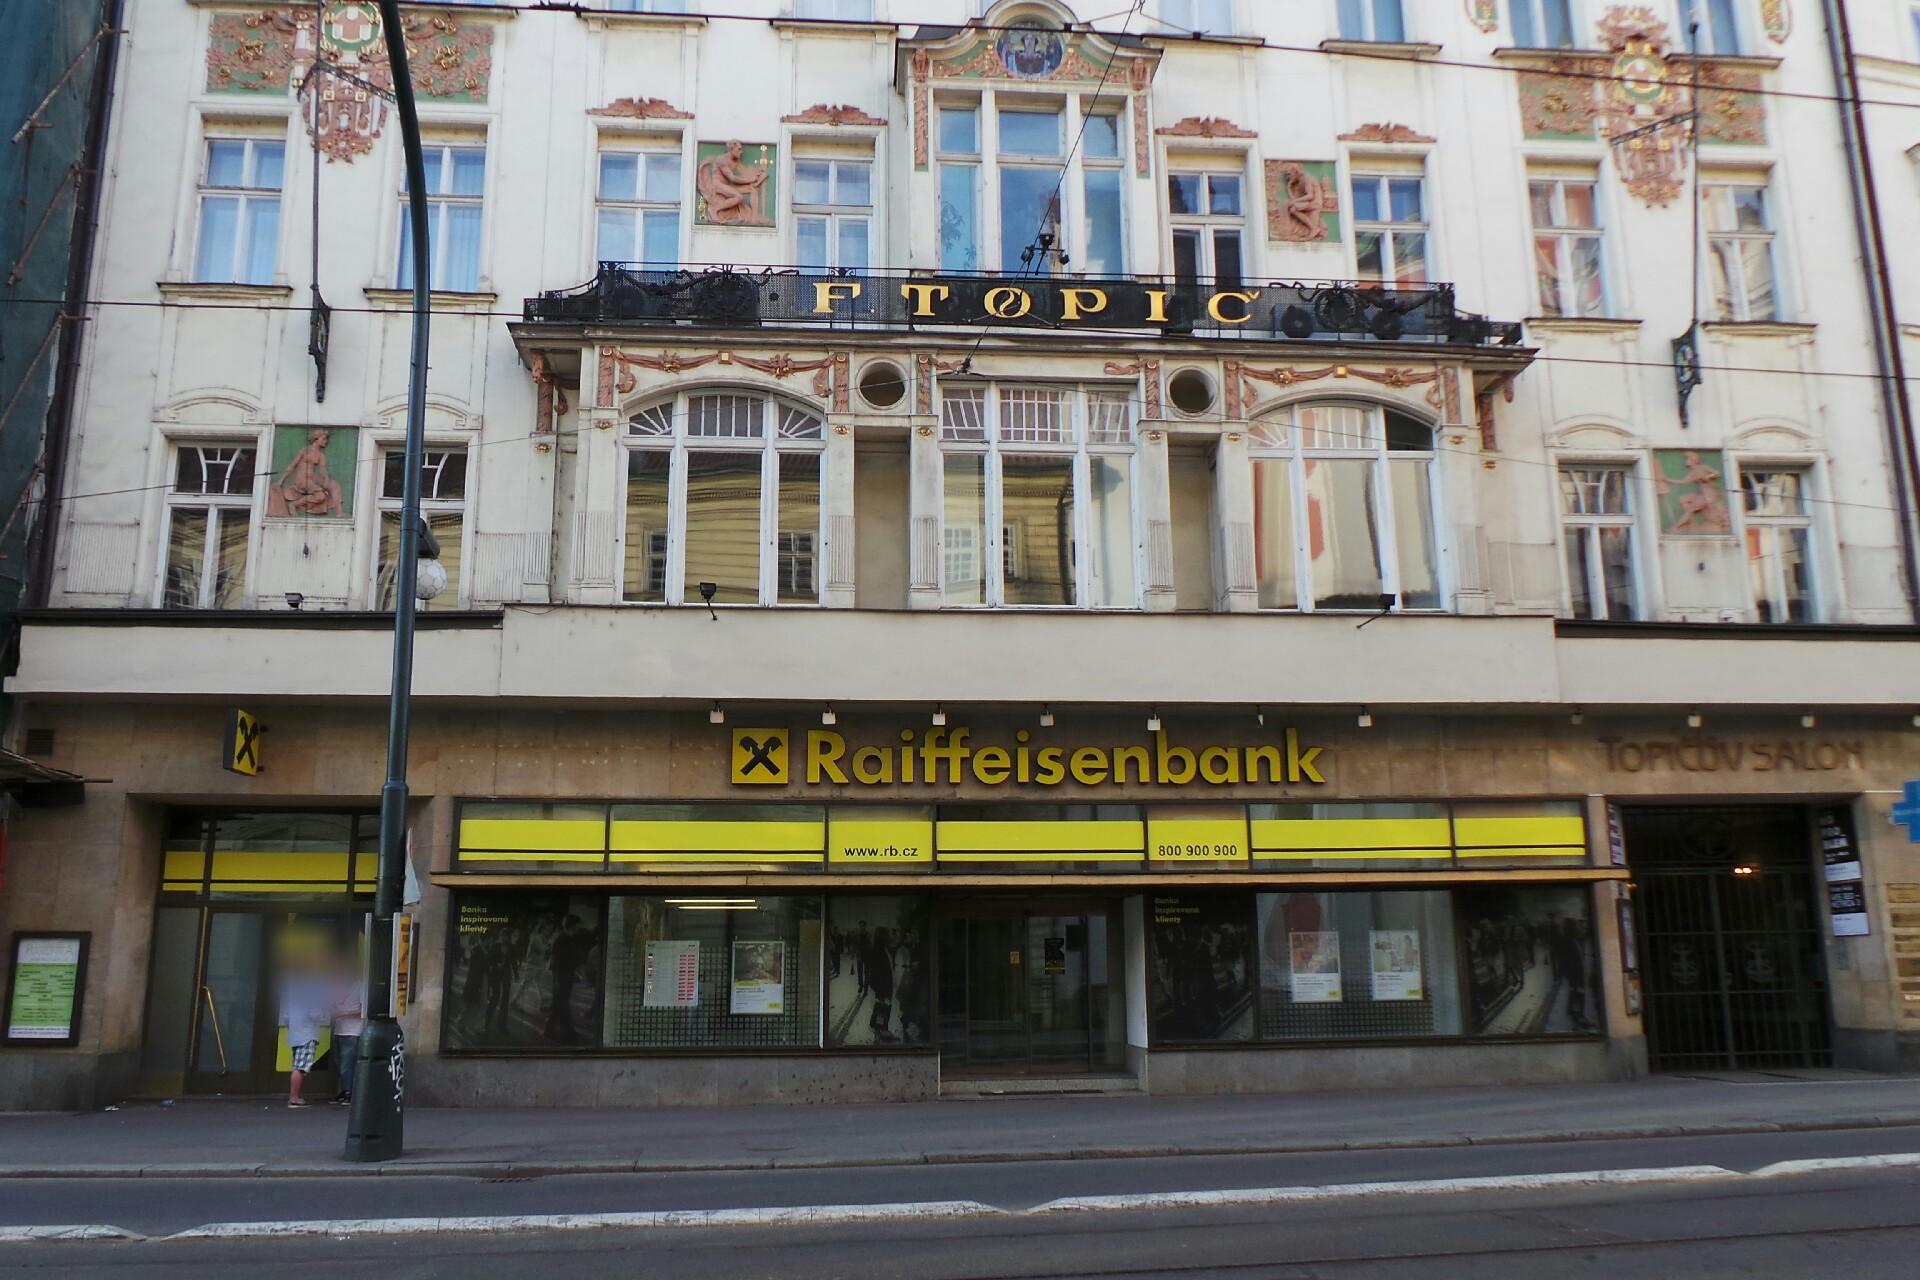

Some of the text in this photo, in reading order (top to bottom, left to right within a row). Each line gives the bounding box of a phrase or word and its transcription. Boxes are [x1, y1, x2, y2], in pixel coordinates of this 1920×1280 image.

[806, 726, 1326, 785] Raiffeisenbank
[1751, 740, 1864, 772] SALON
[844, 845, 919, 857] www.rb.cz
[1158, 844, 1238, 857] 800 900 900
[460, 924, 487, 934] klienty
